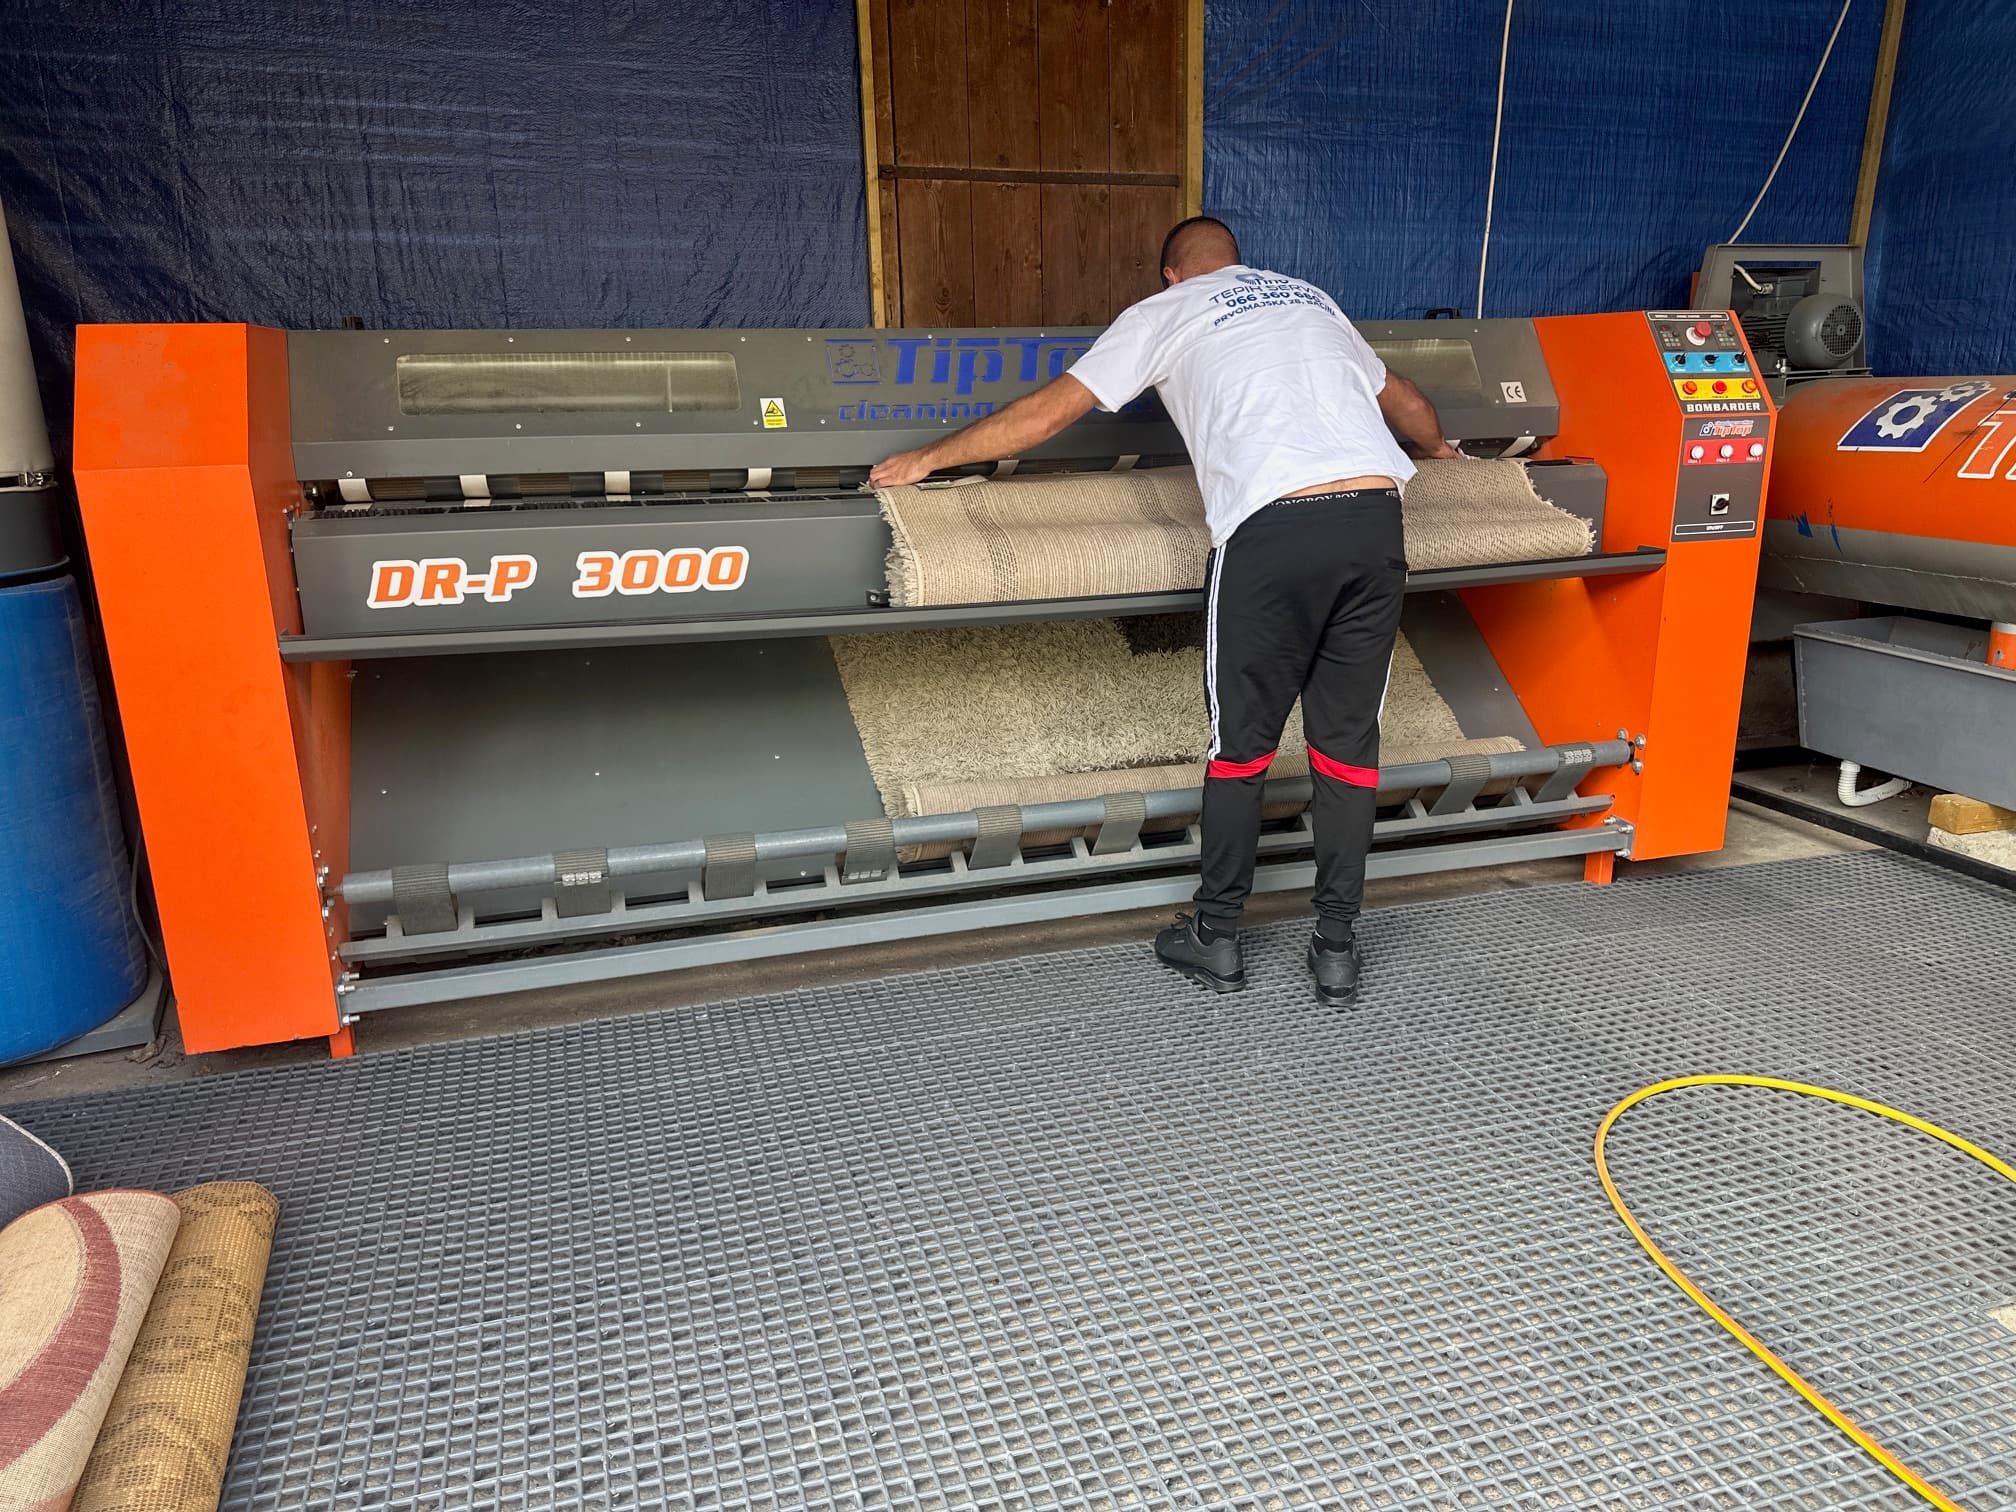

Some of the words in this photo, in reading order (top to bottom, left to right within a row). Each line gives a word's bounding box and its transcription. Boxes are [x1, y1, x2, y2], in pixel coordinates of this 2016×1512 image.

[1226, 294, 1257, 307] 066
[1506, 385, 1522, 398] CE
[1686, 402, 1760, 412] BOMBARDER
[367, 555, 538, 609] DR-P
[572, 545, 750, 598] 3000
